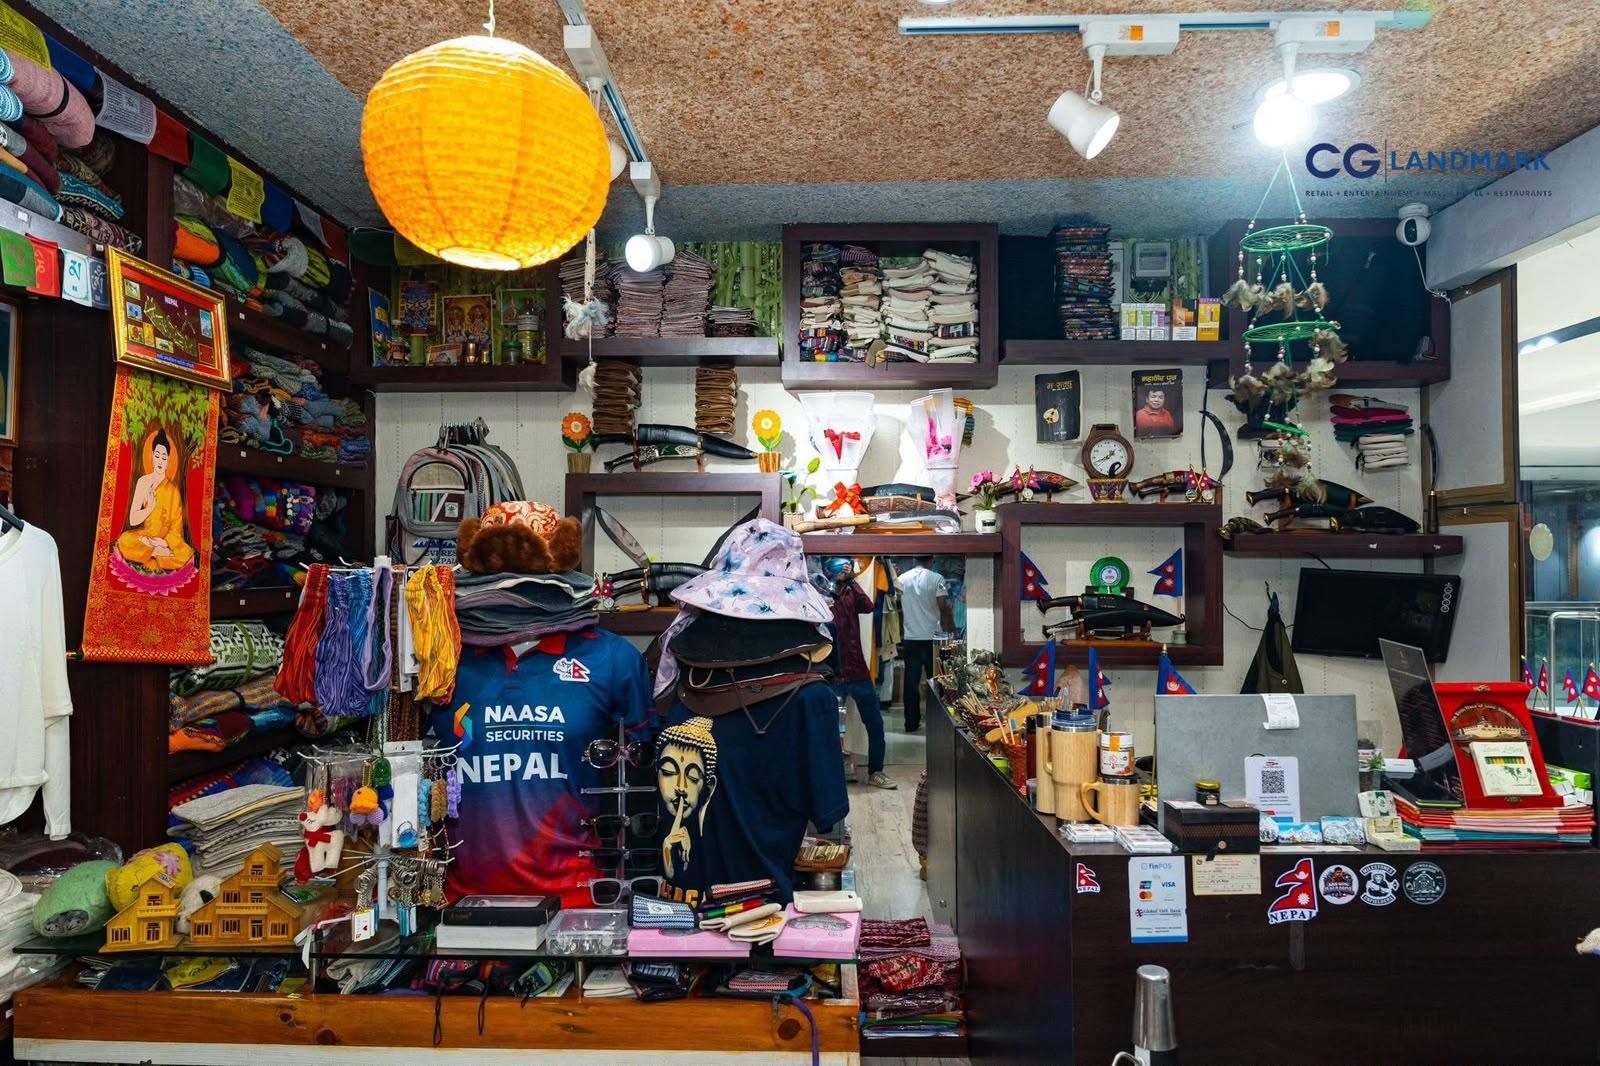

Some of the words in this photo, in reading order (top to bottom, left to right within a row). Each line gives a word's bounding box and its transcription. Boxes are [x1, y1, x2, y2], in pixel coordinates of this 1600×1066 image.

[484, 705, 566, 723] NAASA
[486, 730, 564, 742] SECURITIES
[456, 752, 568, 784] NEPAL
[1270, 910, 1315, 923] NEPAL
